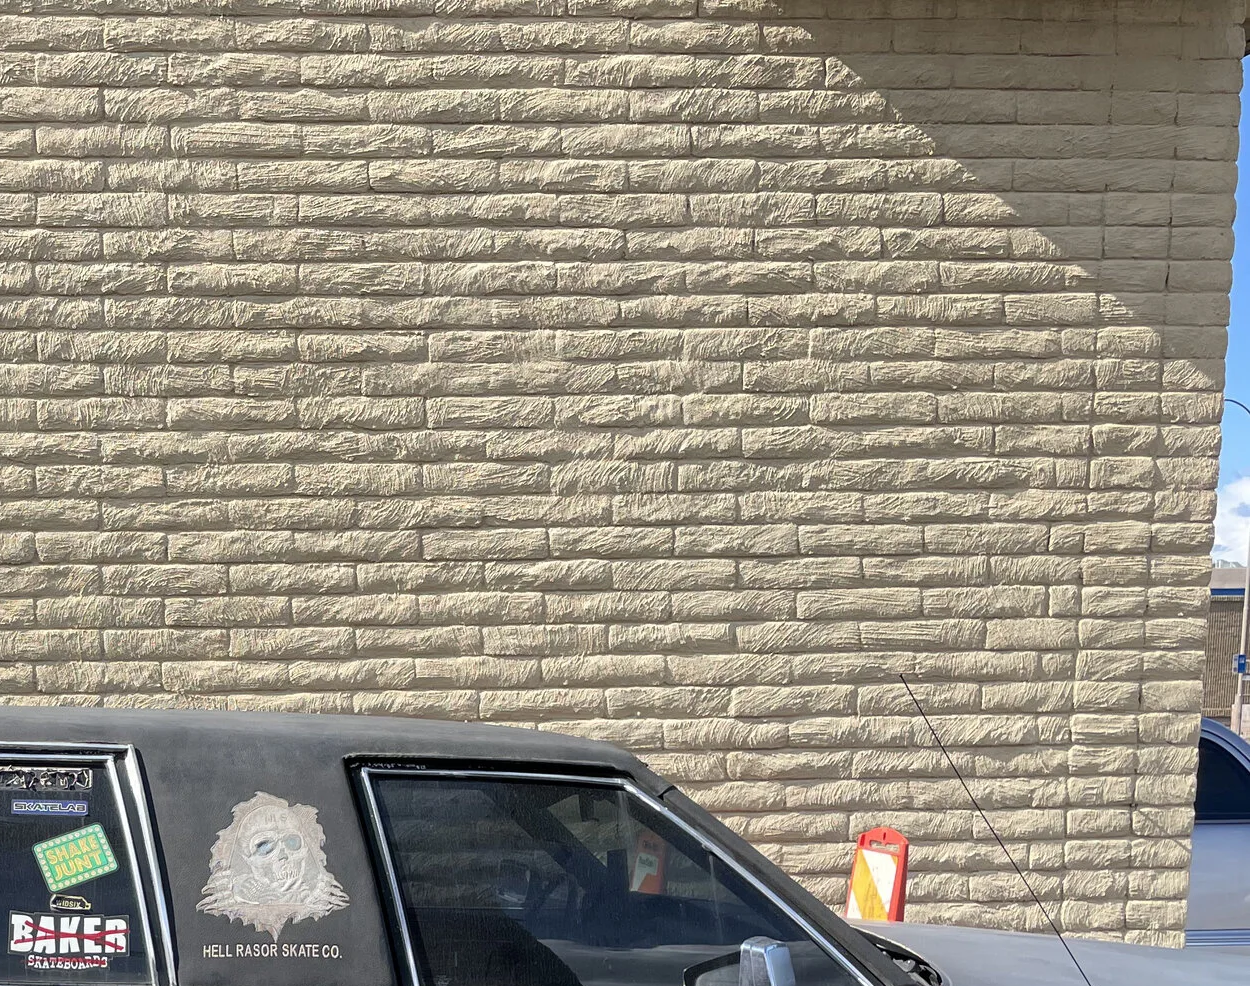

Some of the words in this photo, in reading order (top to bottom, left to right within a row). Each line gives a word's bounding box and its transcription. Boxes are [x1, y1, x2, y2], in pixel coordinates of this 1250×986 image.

[13, 802, 88, 813] SKATELAB
[46, 834, 99, 865] SHAKE
[54, 849, 102, 881] JUNT
[10, 914, 128, 954] BAKER
[27, 954, 108, 970] SKATEBOARDS
[203, 944, 233, 959] HELL
[236, 943, 279, 958] RASOR
[281, 943, 320, 958] SKATE
[321, 944, 344, 960] CO.
